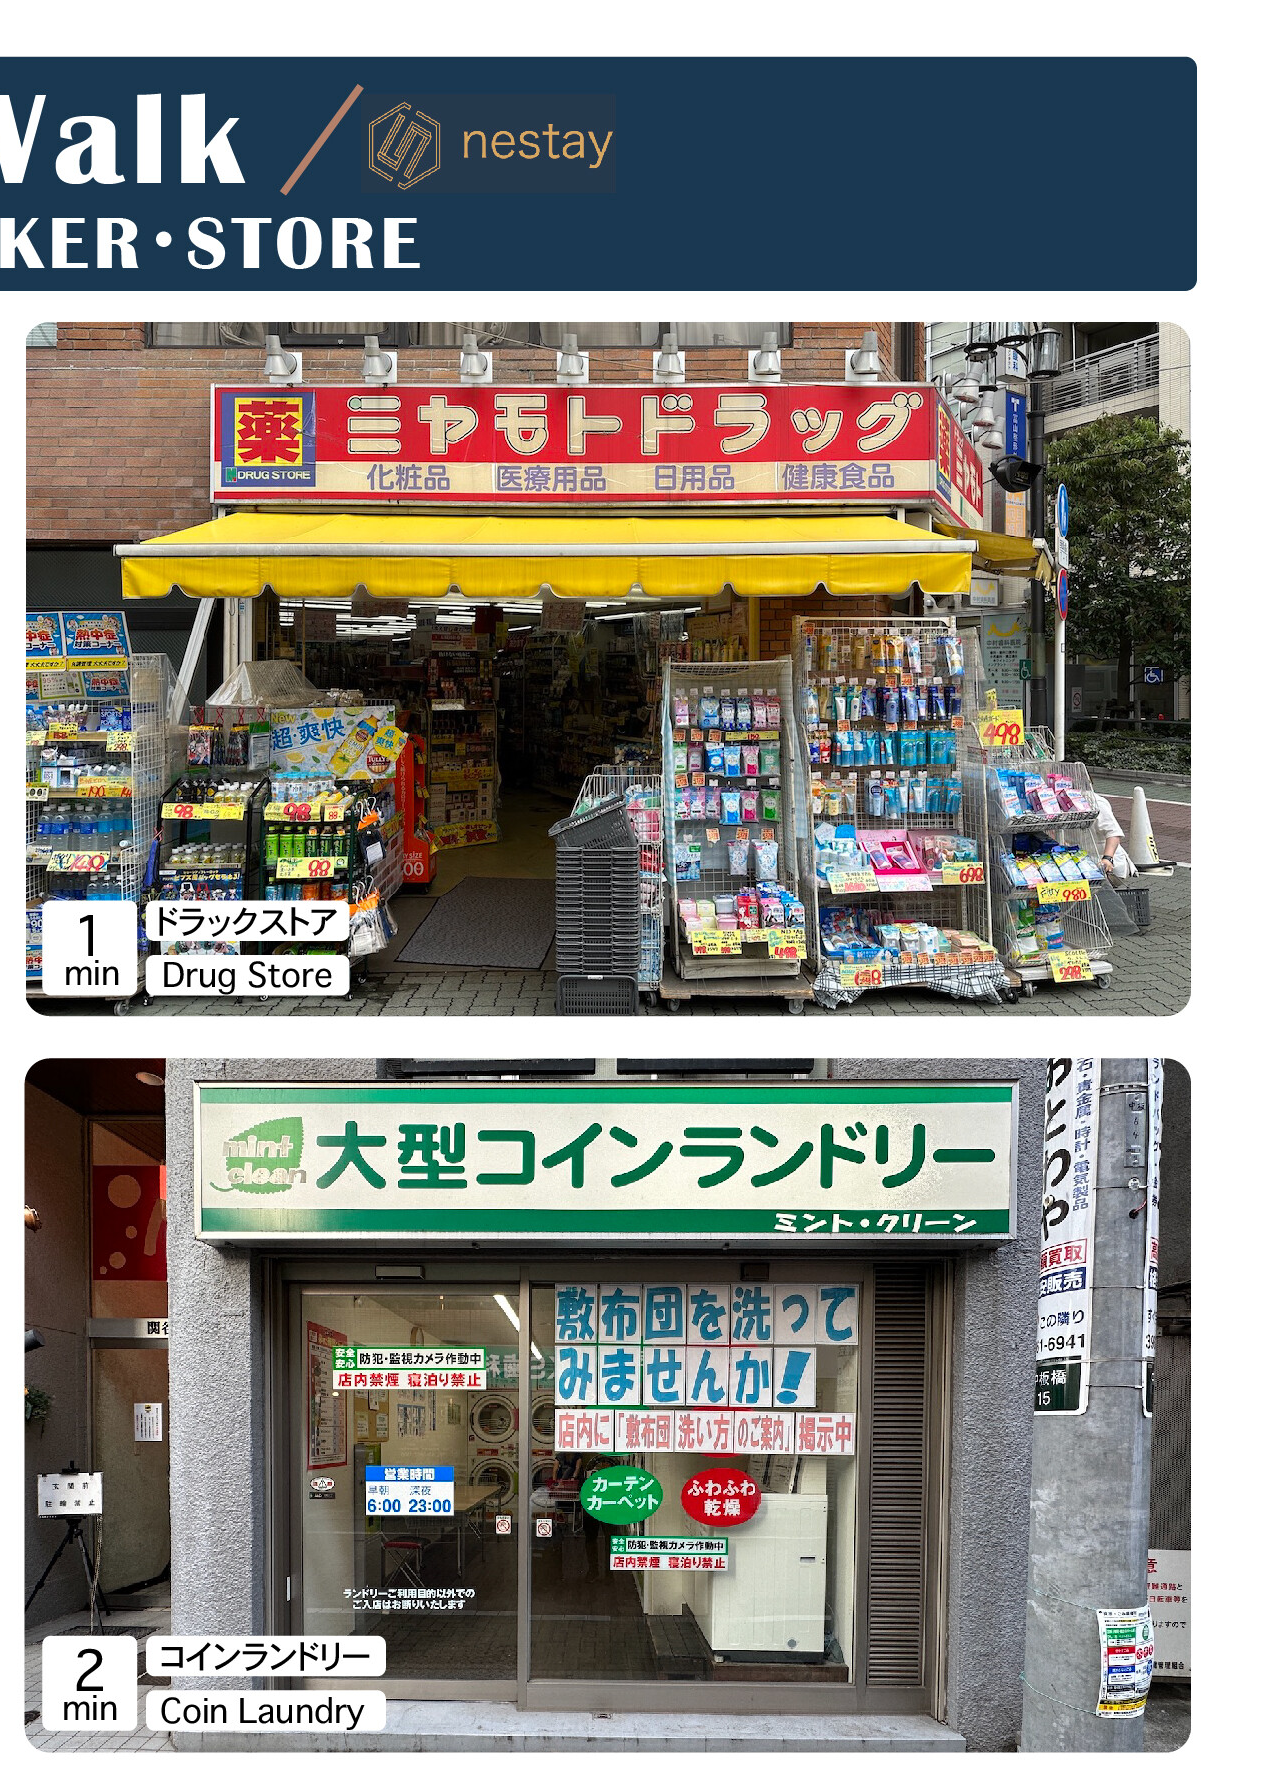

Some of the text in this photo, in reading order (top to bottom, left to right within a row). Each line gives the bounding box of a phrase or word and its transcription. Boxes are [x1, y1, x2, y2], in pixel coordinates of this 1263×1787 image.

[346, 391, 924, 456] ミヤモトドラッグ
[238, 401, 302, 466] 薬
[239, 471, 311, 481] DRUG STORE
[366, 462, 895, 492] 化粧品 医療用品 日用品 健康食品
[270, 712, 296, 724] New
[222, 1132, 294, 1159] mint
[316, 1120, 996, 1190] 大型コインランドリー
[227, 1164, 307, 1186] clean
[773, 1212, 978, 1234] ミント・クリーン
[557, 1285, 856, 1342] 敷布団を洗って
[334, 1348, 356, 1358] 安全
[359, 1352, 482, 1365] 防犯・監視カメラ作動中
[334, 1359, 356, 1368] 安心
[338, 1374, 482, 1387] 店内禁煙 寝泊り禁止
[559, 1346, 811, 1404] みませんか!
[384, 1467, 436, 1481] 営業時間
[367, 1485, 432, 1495] 早朝 深夜
[592, 1476, 655, 1492] カーテン
[687, 1480, 756, 1497] ふわふわ
[367, 1499, 452, 1513] 6:00 23:00
[587, 1494, 659, 1511] カーペット
[703, 1498, 741, 1516] 乾燥
[613, 1556, 726, 1569] 店内禁煙 寝泊り禁止
